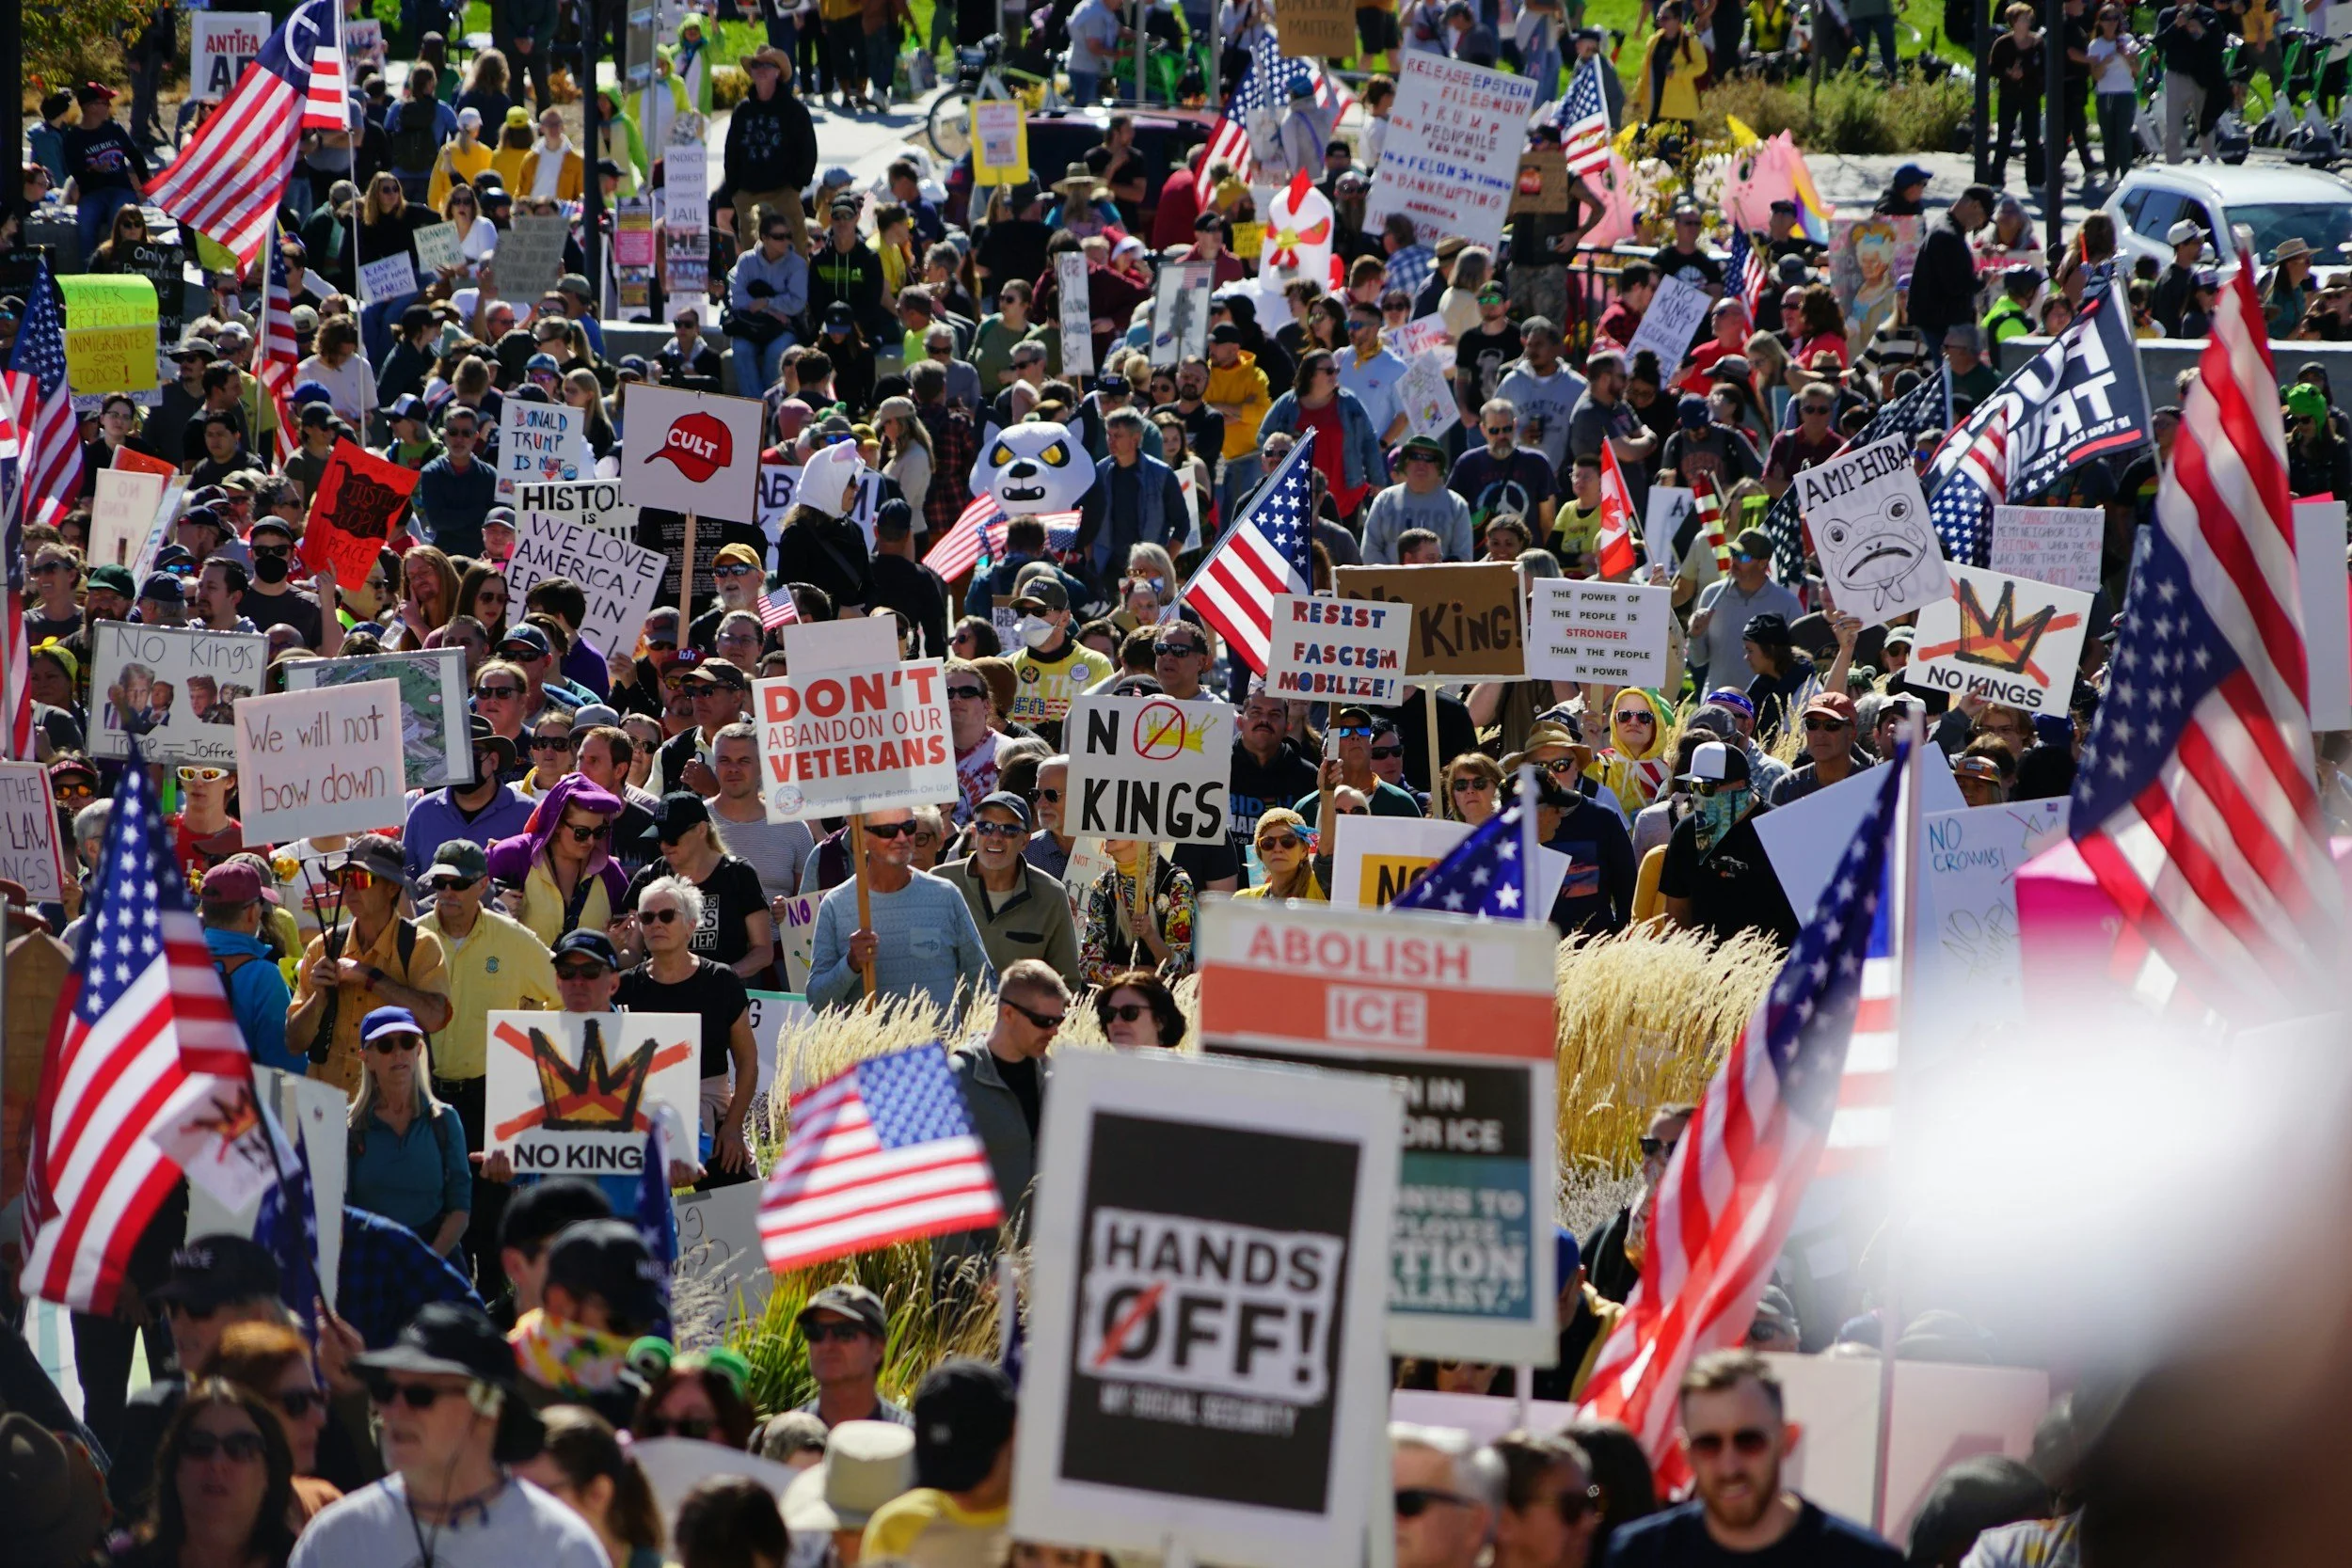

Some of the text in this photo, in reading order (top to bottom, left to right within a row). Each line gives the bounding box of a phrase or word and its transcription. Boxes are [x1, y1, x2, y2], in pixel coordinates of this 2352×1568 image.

[205, 32, 261, 54] ANTIFA
[1288, 19, 1347, 40] MATTERS
[1407, 57, 1533, 99] RELEASE EPSTEIN
[1440, 86, 1528, 117] FILES NOW
[1421, 100, 1501, 135] TRUMP
[85, 140, 120, 155] AMERICA
[669, 152, 704, 164] INDICT
[669, 172, 704, 182] ARREST
[1408, 155, 1456, 178] FELON
[671, 208, 702, 222] JAIL
[134, 245, 167, 270] Only
[67, 286, 127, 308] CANCER
[1671, 283, 1695, 303] NO
[70, 306, 129, 329] RESEARCH
[1660, 294, 1701, 325] KINGS
[71, 329, 151, 355] INMIGRANTES
[1403, 322, 1427, 339] NO
[514, 406, 568, 431] DONALD
[1518, 398, 1565, 415] SEATTLE
[511, 431, 564, 454] TRUMP
[668, 428, 719, 460] CULT
[514, 453, 531, 471] IS
[1806, 441, 1913, 513] AMPHIBA
[582, 511, 597, 526] is
[2053, 513, 2101, 525] CONVINCE
[326, 535, 372, 564] PEACE
[532, 512, 583, 553] WE
[585, 530, 657, 578] LOVE
[515, 538, 643, 600] AMERICA!
[1552, 590, 1641, 603] THE POWER OF
[1292, 600, 1387, 629] RESIST
[1551, 610, 1638, 622] THE PEOPLE IS
[1565, 628, 1629, 641] STRONGER
[188, 633, 256, 674] Kings
[1293, 641, 1399, 670] FASCISM
[1550, 646, 1651, 660] THAN THE PEOPLE
[1278, 671, 1395, 700] MOBILIZE!
[1576, 666, 1629, 677] IN POWER
[764, 666, 939, 724] DON'T
[1927, 665, 2044, 708] NO KINGS
[244, 704, 385, 753] We will not
[767, 707, 944, 751] ABANDON OUR
[186, 738, 236, 759] Joffre
[768, 735, 946, 784] VETERANS
[0, 776, 41, 804] THE
[259, 763, 386, 814] bow down
[805, 784, 953, 808] Progress from the Bottom On Up!
[1081, 778, 1225, 839] KINGS
[6, 811, 49, 850] LAW
[1929, 817, 1963, 853] NO
[0, 856, 51, 892] NGS
[1073, 853, 1091, 868] NOT
[1933, 846, 2009, 873] CROWNS!
[787, 898, 813, 927] NO
[1248, 923, 1470, 981] ABOLISH
[1942, 909, 1983, 966] NO
[1333, 993, 1421, 1037] ICE
[1447, 1117, 1503, 1153] ICE
[513, 1144, 644, 1170] NO KING
[1475, 1188, 1526, 1220] TO
[1105, 1223, 1322, 1294] HANDS
[1099, 1282, 1320, 1384] OFF!
